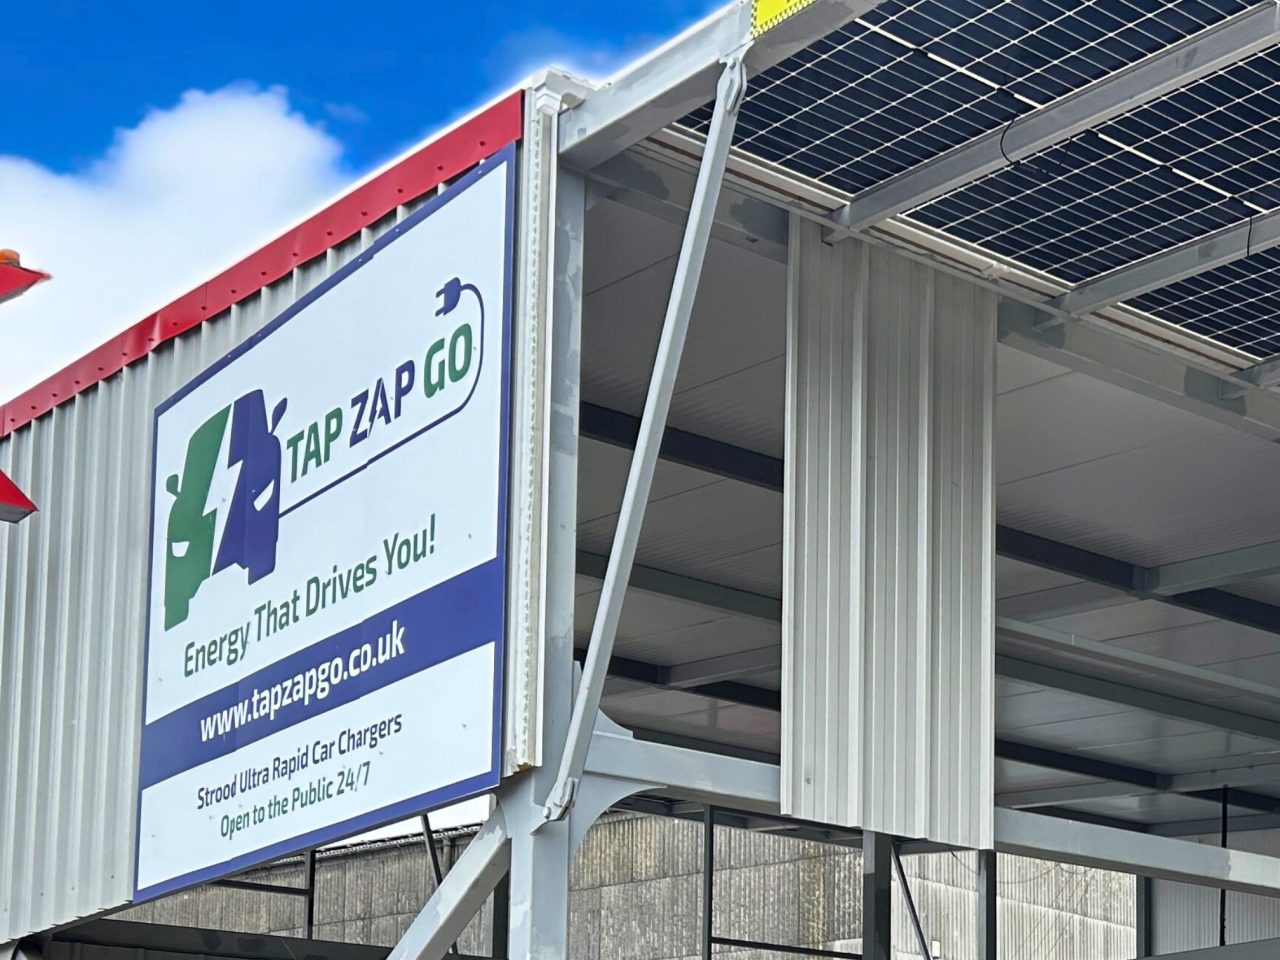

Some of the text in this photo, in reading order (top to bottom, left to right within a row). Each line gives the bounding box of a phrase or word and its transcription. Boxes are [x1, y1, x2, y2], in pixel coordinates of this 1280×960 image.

[287, 323, 473, 483] TAP ZAP GO
[184, 513, 436, 678] Energy That Drives You!
[200, 619, 405, 742] www.tapzapgo.co.uk
[197, 713, 402, 810] Strood Ultra Rapid Car Chargers
[220, 760, 371, 840] Open to the Public 24/7
